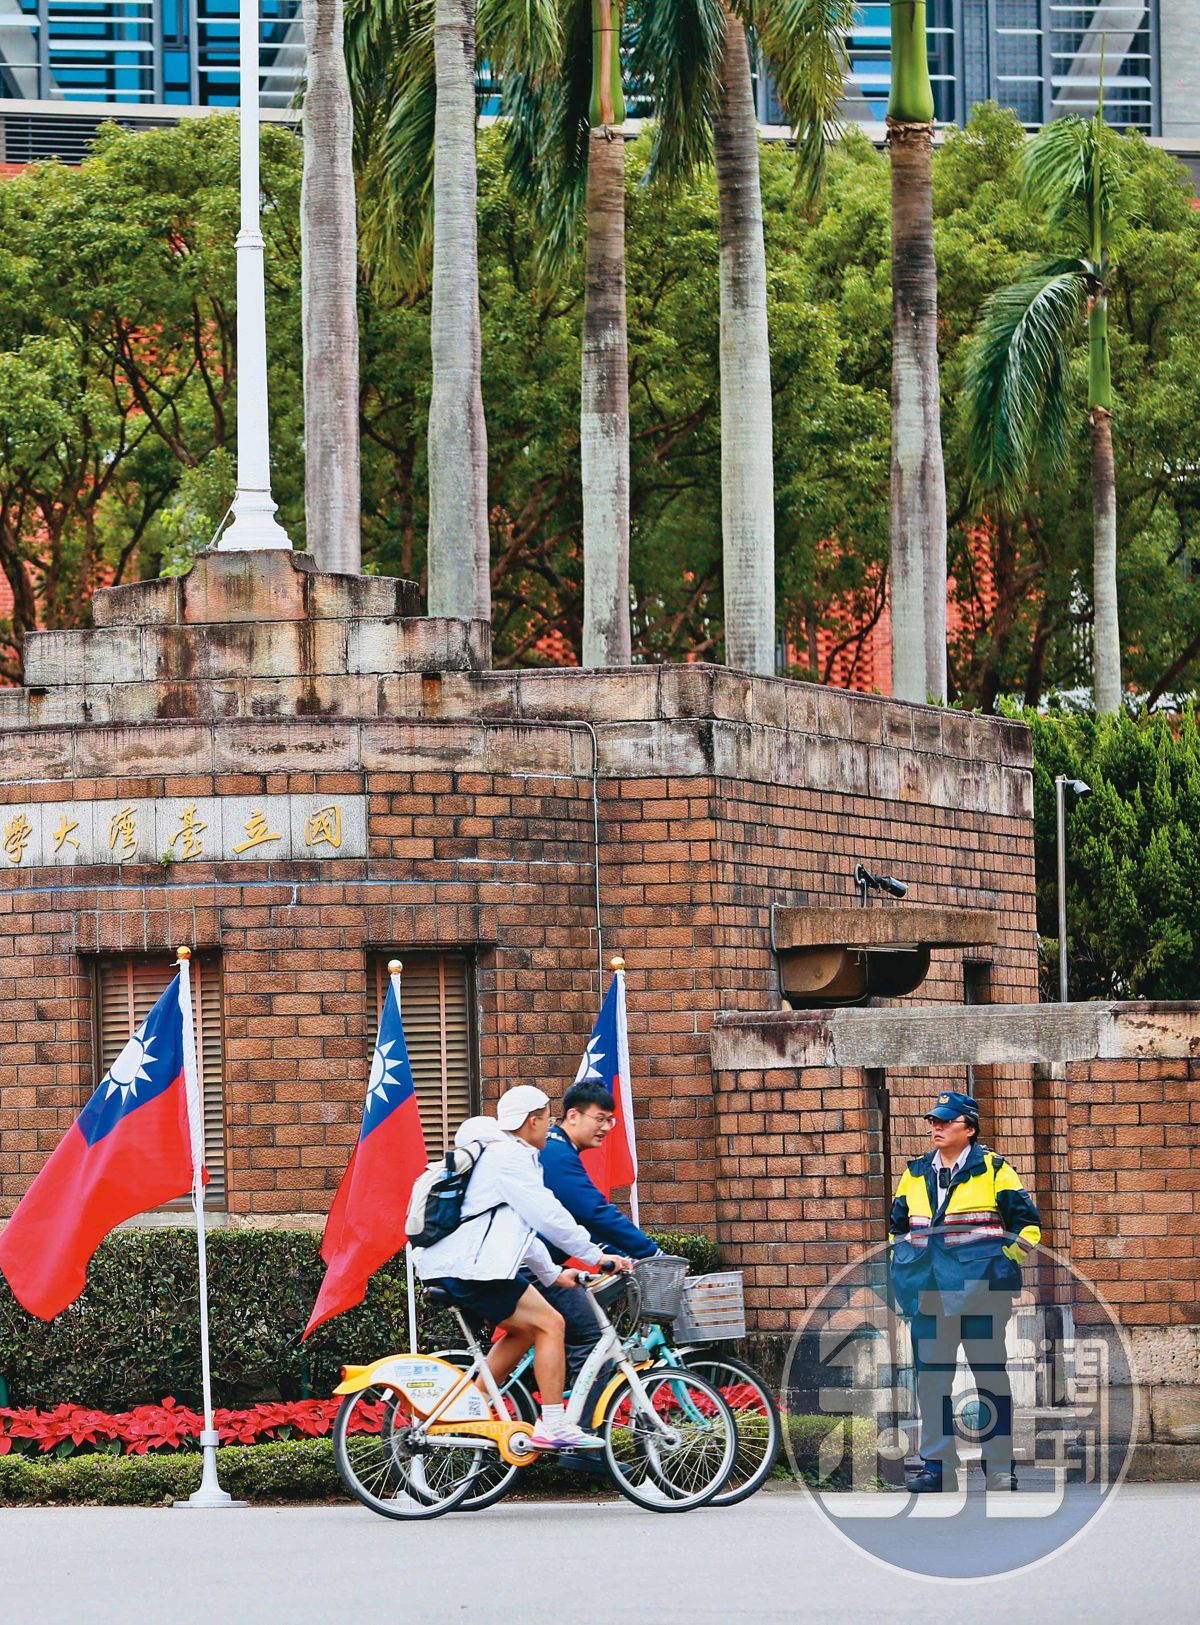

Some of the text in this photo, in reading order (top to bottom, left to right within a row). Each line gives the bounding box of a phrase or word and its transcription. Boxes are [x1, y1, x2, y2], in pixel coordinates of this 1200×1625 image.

[3, 802, 342, 863] 國立臺灣大學
